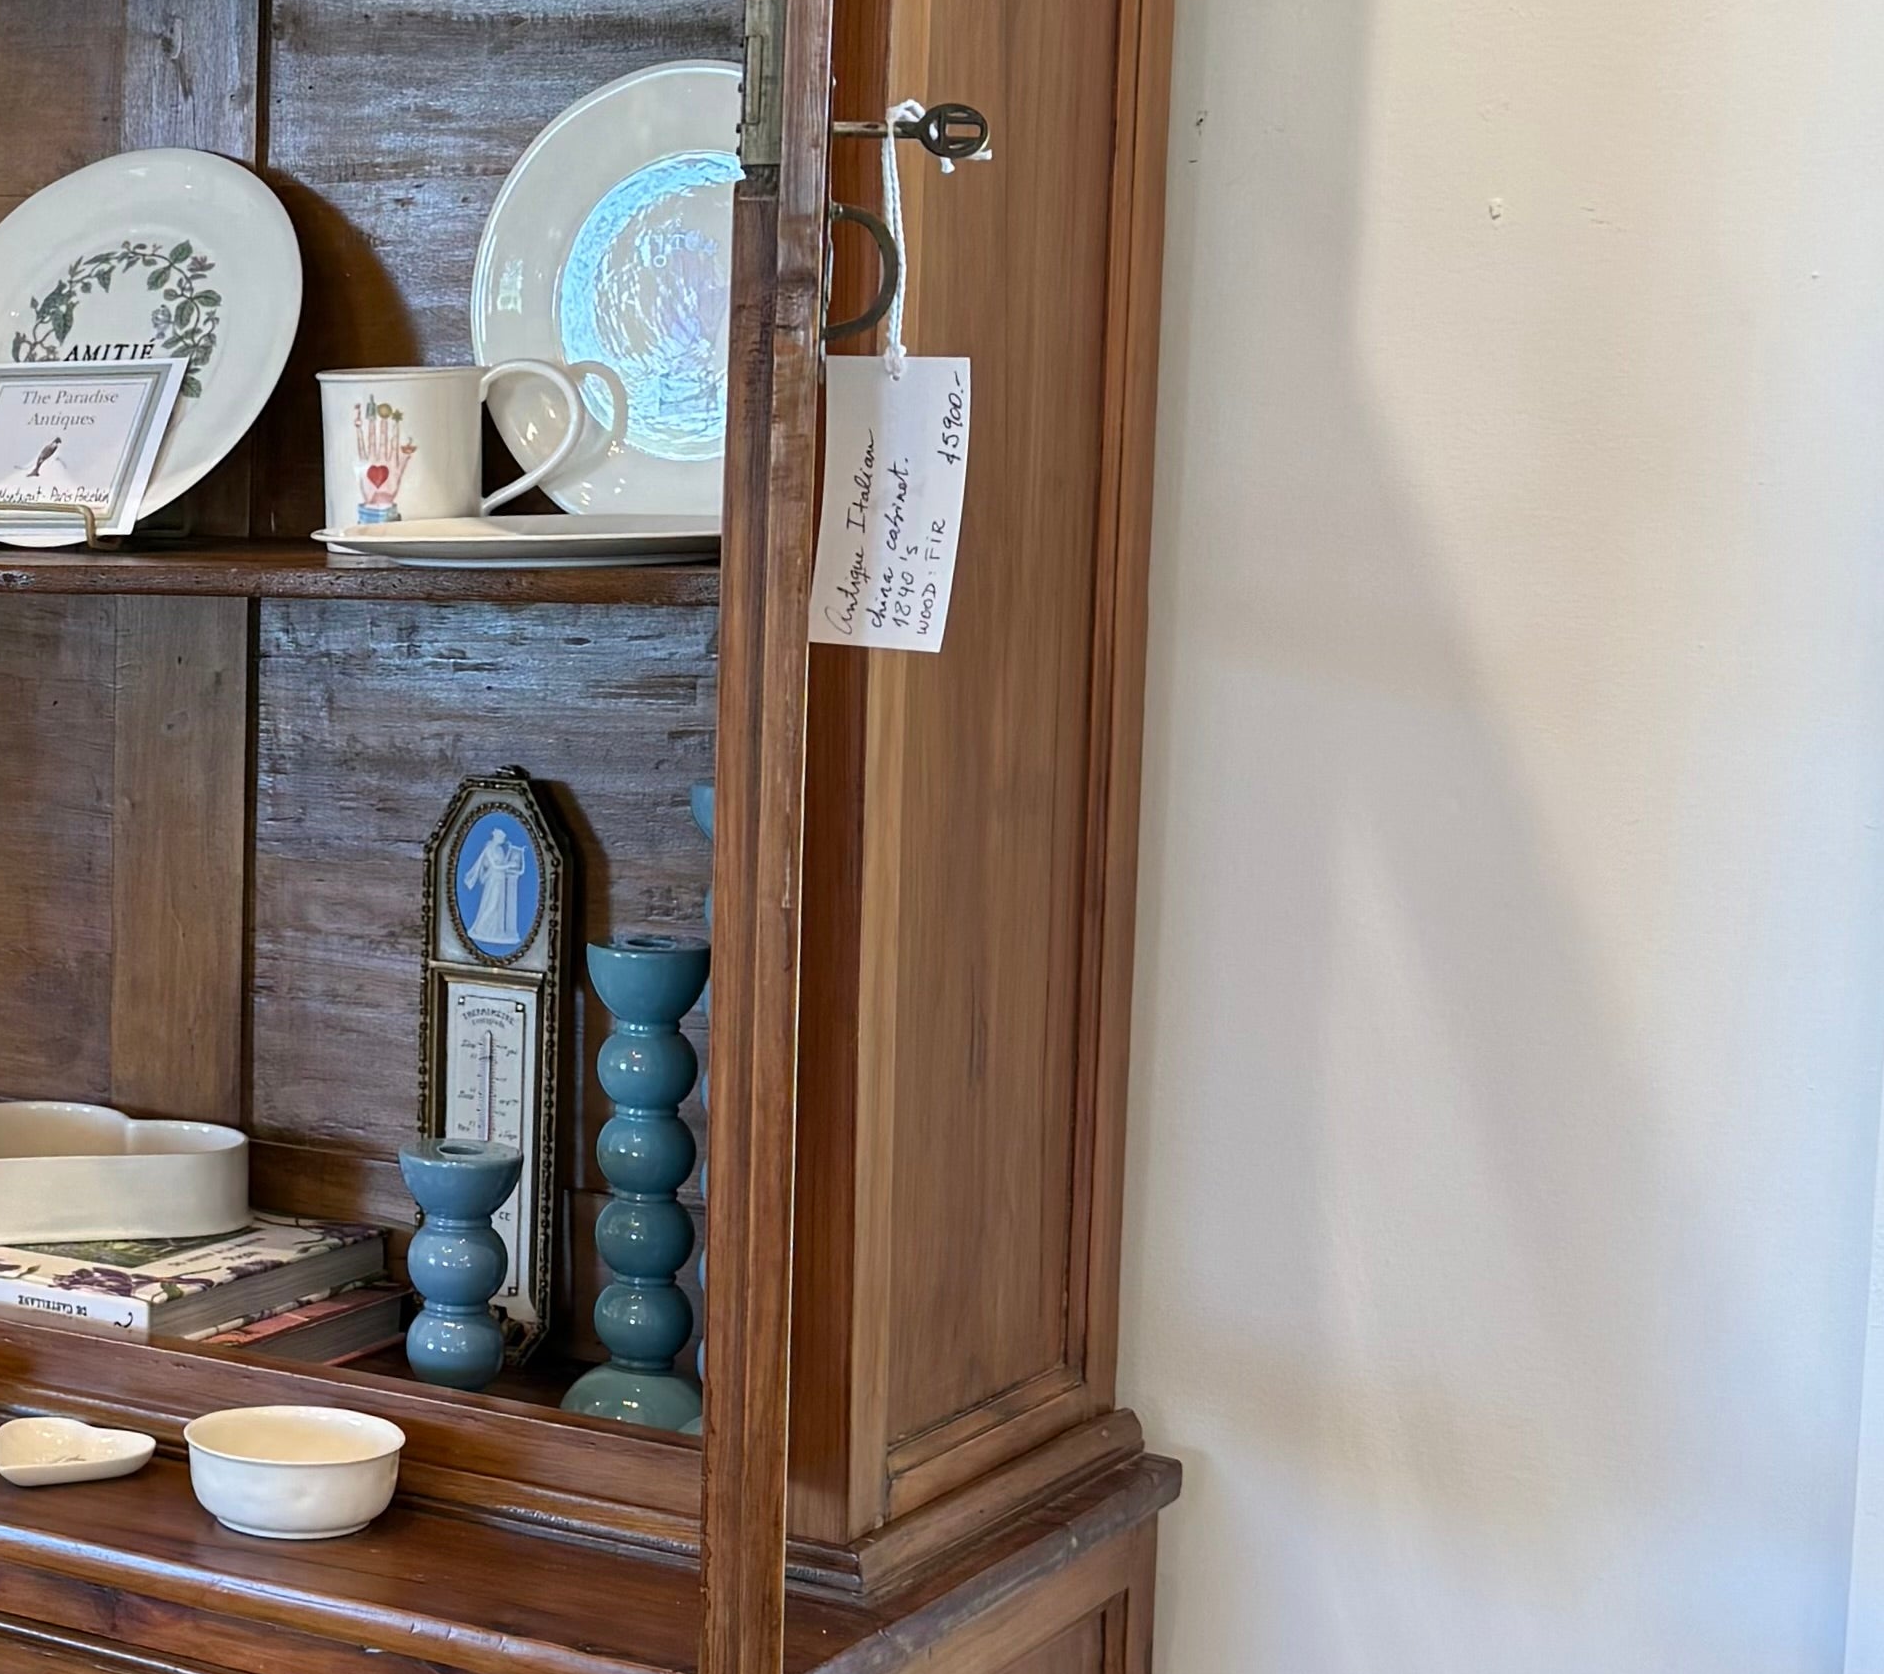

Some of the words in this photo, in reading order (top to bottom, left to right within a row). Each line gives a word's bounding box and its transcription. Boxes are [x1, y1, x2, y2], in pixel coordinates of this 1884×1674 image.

[63, 338, 157, 361] AMITIÉ
[22, 390, 51, 405] The
[55, 388, 119, 404] Paradise
[27, 411, 96, 431] Antiques
[846, 428, 878, 531] Italian
[824, 547, 871, 636] Antique
[866, 566, 895, 629] china
